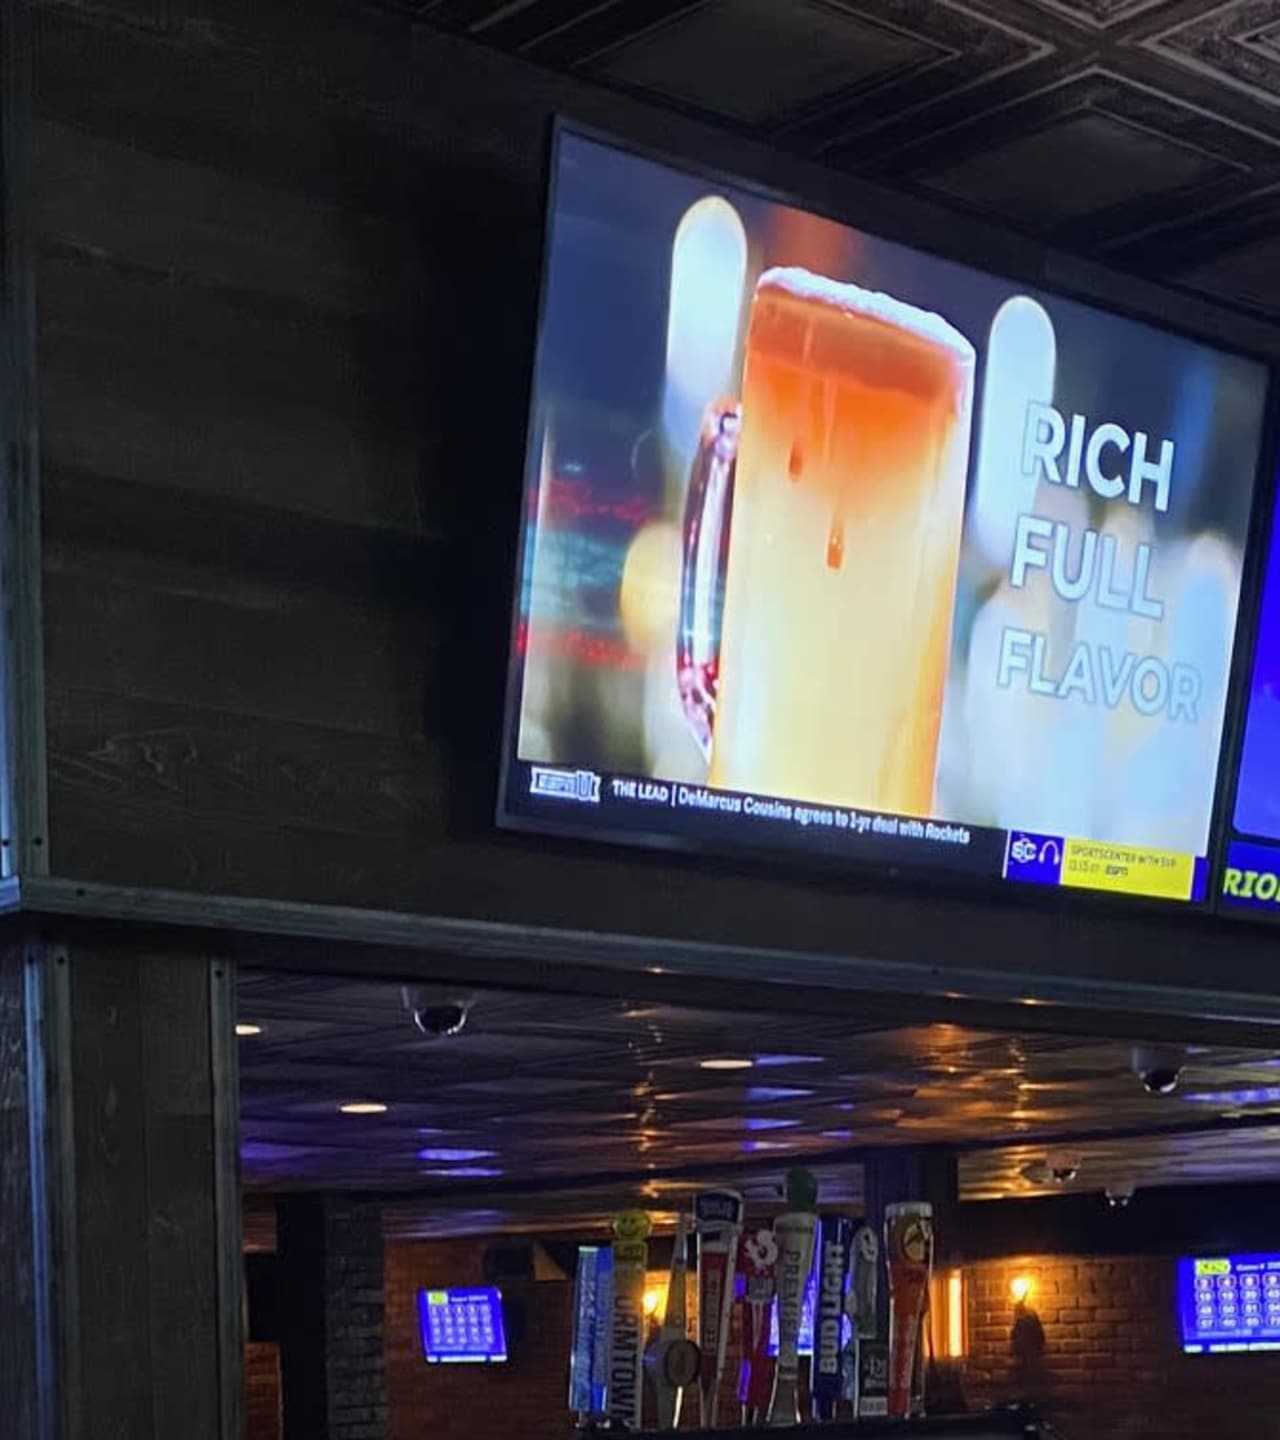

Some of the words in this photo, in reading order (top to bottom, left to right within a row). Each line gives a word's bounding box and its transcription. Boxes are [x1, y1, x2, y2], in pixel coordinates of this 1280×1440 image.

[1021, 401, 1174, 512] RICH
[1010, 514, 1163, 622] FULL
[996, 626, 1202, 724] FLAVOR
[612, 779, 636, 798] THE
[637, 783, 669, 802] LEAD
[678, 786, 742, 813] DeMarcus
[743, 796, 792, 820] Cousins
[793, 806, 833, 826] agrees
[835, 810, 848, 827] to
[925, 823, 971, 844] Rockets
[822, 1240, 844, 1315] LIGHT
[821, 1319, 839, 1374] BUD
